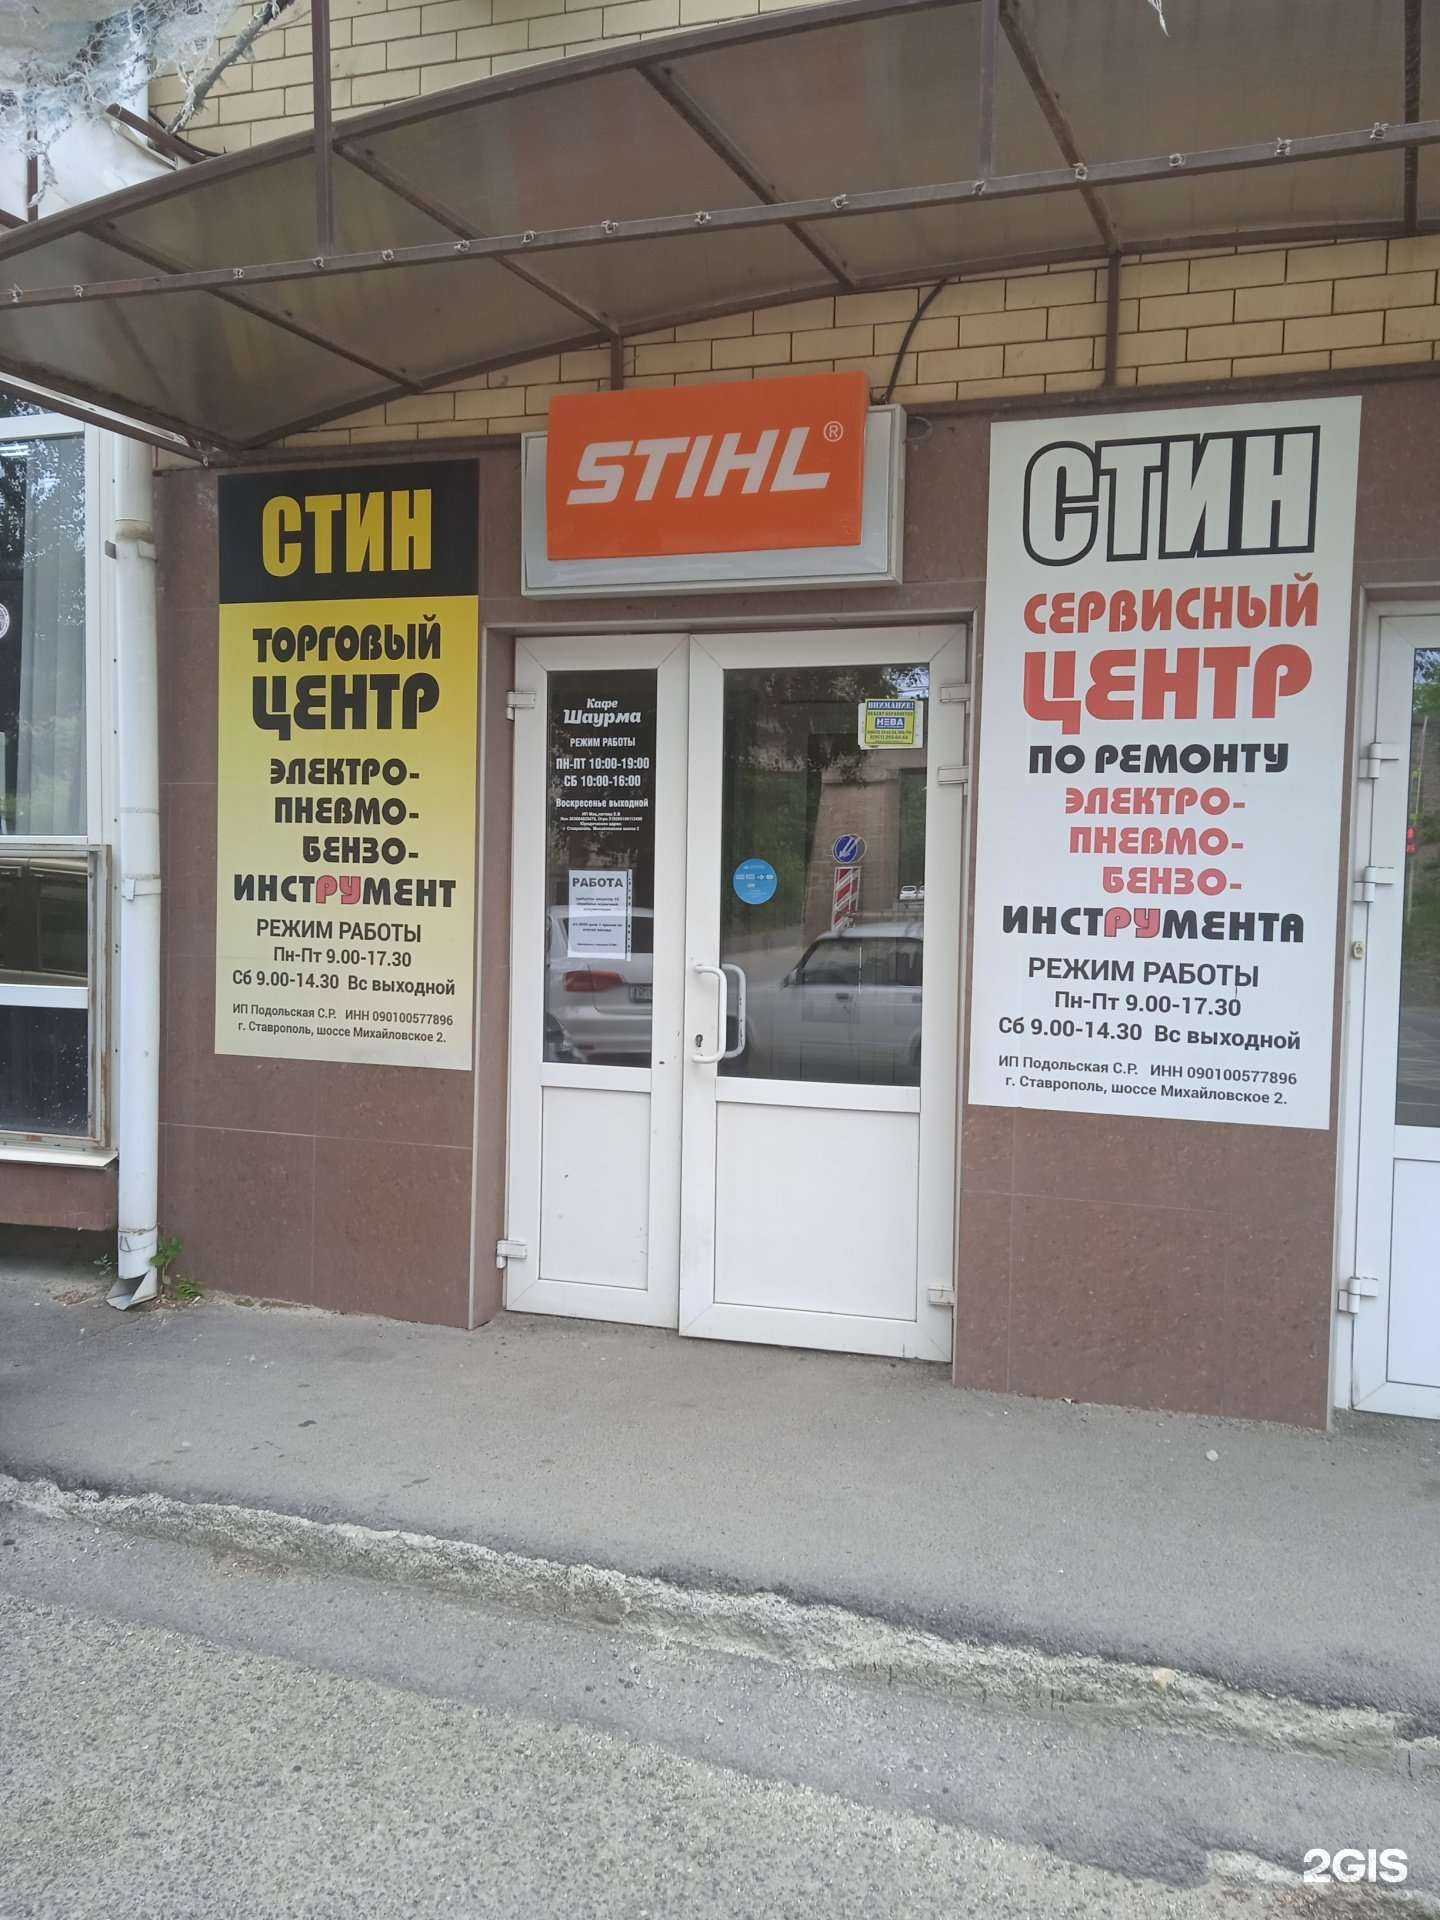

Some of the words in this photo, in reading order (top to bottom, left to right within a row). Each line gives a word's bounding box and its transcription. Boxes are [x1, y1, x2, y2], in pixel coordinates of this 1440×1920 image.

[566, 427, 831, 505] STIHL
[1022, 425, 1321, 567] СТИН
[262, 488, 432, 577] СТИН
[1023, 572, 1319, 635] СЕРВИСНЫЙ
[252, 614, 441, 662] ТОРГОВЫЙ
[586, 698, 619, 710] Кафе
[1023, 644, 1312, 735] ЦЕНТР
[252, 673, 440, 740] ЦЕНТР
[563, 709, 641, 727] Шаурма
[570, 738, 600, 747] РЕЖИМ
[602, 737, 636, 747] РАБОТЫ
[270, 758, 419, 786] ЭЛЕКТРО-
[556, 758, 586, 769] ПН-ПТ
[589, 757, 650, 769] 10:00-19:00
[1029, 744, 1085, 774] ПО
[1095, 743, 1289, 773] РЕМОНТУ
[564, 775, 577, 787] СБ
[580, 775, 641, 787] 10:00-16:00
[274, 797, 419, 825] ПНЕВМО-
[555, 798, 607, 809] Воскресенье
[609, 798, 649, 808] выходной
[1065, 787, 1245, 815] ЭЛЕКТРО-
[302, 835, 419, 865] БЕНЗО-
[1069, 826, 1243, 856] ПНЕВМО-
[234, 873, 456, 907] ИНСТРУМЕНТ
[572, 878, 623, 887] РАБОТА
[1102, 866, 1242, 895] БЕНЗО-
[256, 919, 332, 939] РЕЖИМ
[339, 922, 421, 942] РАБОТЫ
[1002, 905, 1304, 943] ИНСТРУМЕНТА
[273, 947, 322, 963] Пн-Пт
[326, 949, 412, 967] 9.00-17.30
[232, 970, 251, 985] Сб
[256, 971, 339, 989] 9.00-14.30
[348, 975, 367, 991] Вс
[372, 979, 455, 996] выходной
[1028, 957, 1134, 983] РЕЖИМ
[1143, 961, 1259, 987] РАБОТЫ
[232, 1003, 248, 1014] ИП
[251, 1004, 315, 1019] Подольская
[317, 1007, 337, 1019] С.Р.
[345, 1009, 370, 1021] ИНН
[372, 1010, 453, 1026] 090100577896
[1055, 991, 1120, 1010] Пн-Пт
[1125, 994, 1242, 1016] 9.00-17.30
[238, 1023, 246, 1032] г.
[249, 1021, 314, 1036] Ставрополь,
[317, 1028, 350, 1037] шоссе
[353, 1026, 434, 1042] Михайловское
[436, 1032, 446, 1043] 2.
[999, 1016, 1024, 1034] Сб
[1030, 1020, 1142, 1041] 9.00-14.30
[1155, 1025, 1181, 1043] Вс
[1187, 1030, 1301, 1050] выходной
[998, 1054, 1019, 1067] ИП
[1023, 1056, 1109, 1074] Подольская
[1113, 1061, 1138, 1075] С.Р.
[1150, 1064, 1183, 1078] ИНН
[1187, 1065, 1297, 1085] 090100577896
[1005, 1078, 1015, 1087] г.
[1019, 1075, 1107, 1095] Ставрополь,
[1111, 1083, 1157, 1096] шоссе
[1161, 1084, 1269, 1104] Михайловское
[1274, 1091, 1288, 1105] 2.
